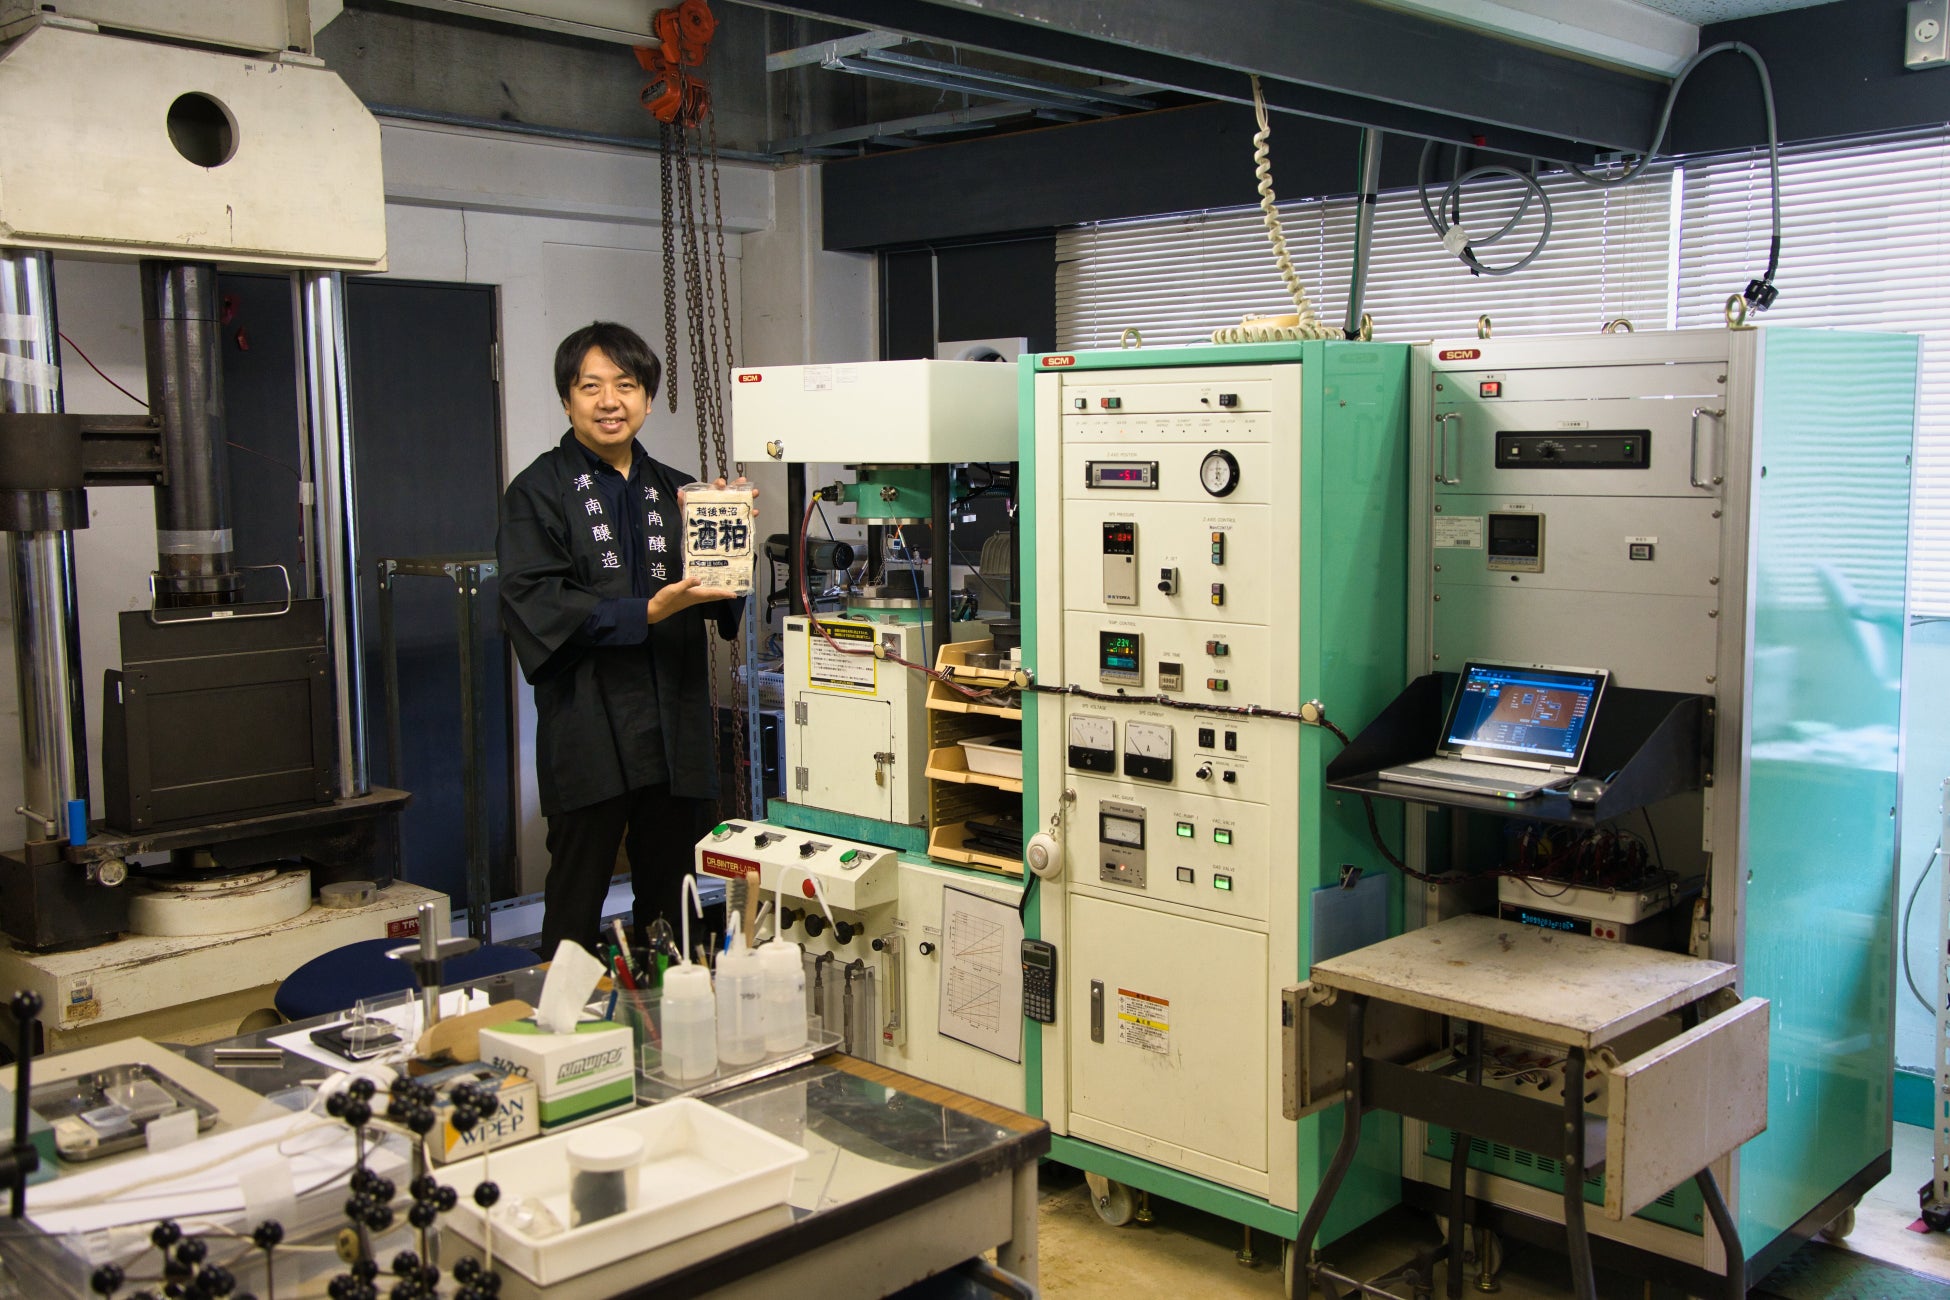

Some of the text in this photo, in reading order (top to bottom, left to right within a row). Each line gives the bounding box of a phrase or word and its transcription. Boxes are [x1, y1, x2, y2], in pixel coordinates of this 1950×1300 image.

[1446, 351, 1473, 360] SCM
[1048, 357, 1069, 365] SCM
[696, 506, 738, 517] 越後魚沼
[689, 518, 748, 552] 酒粕
